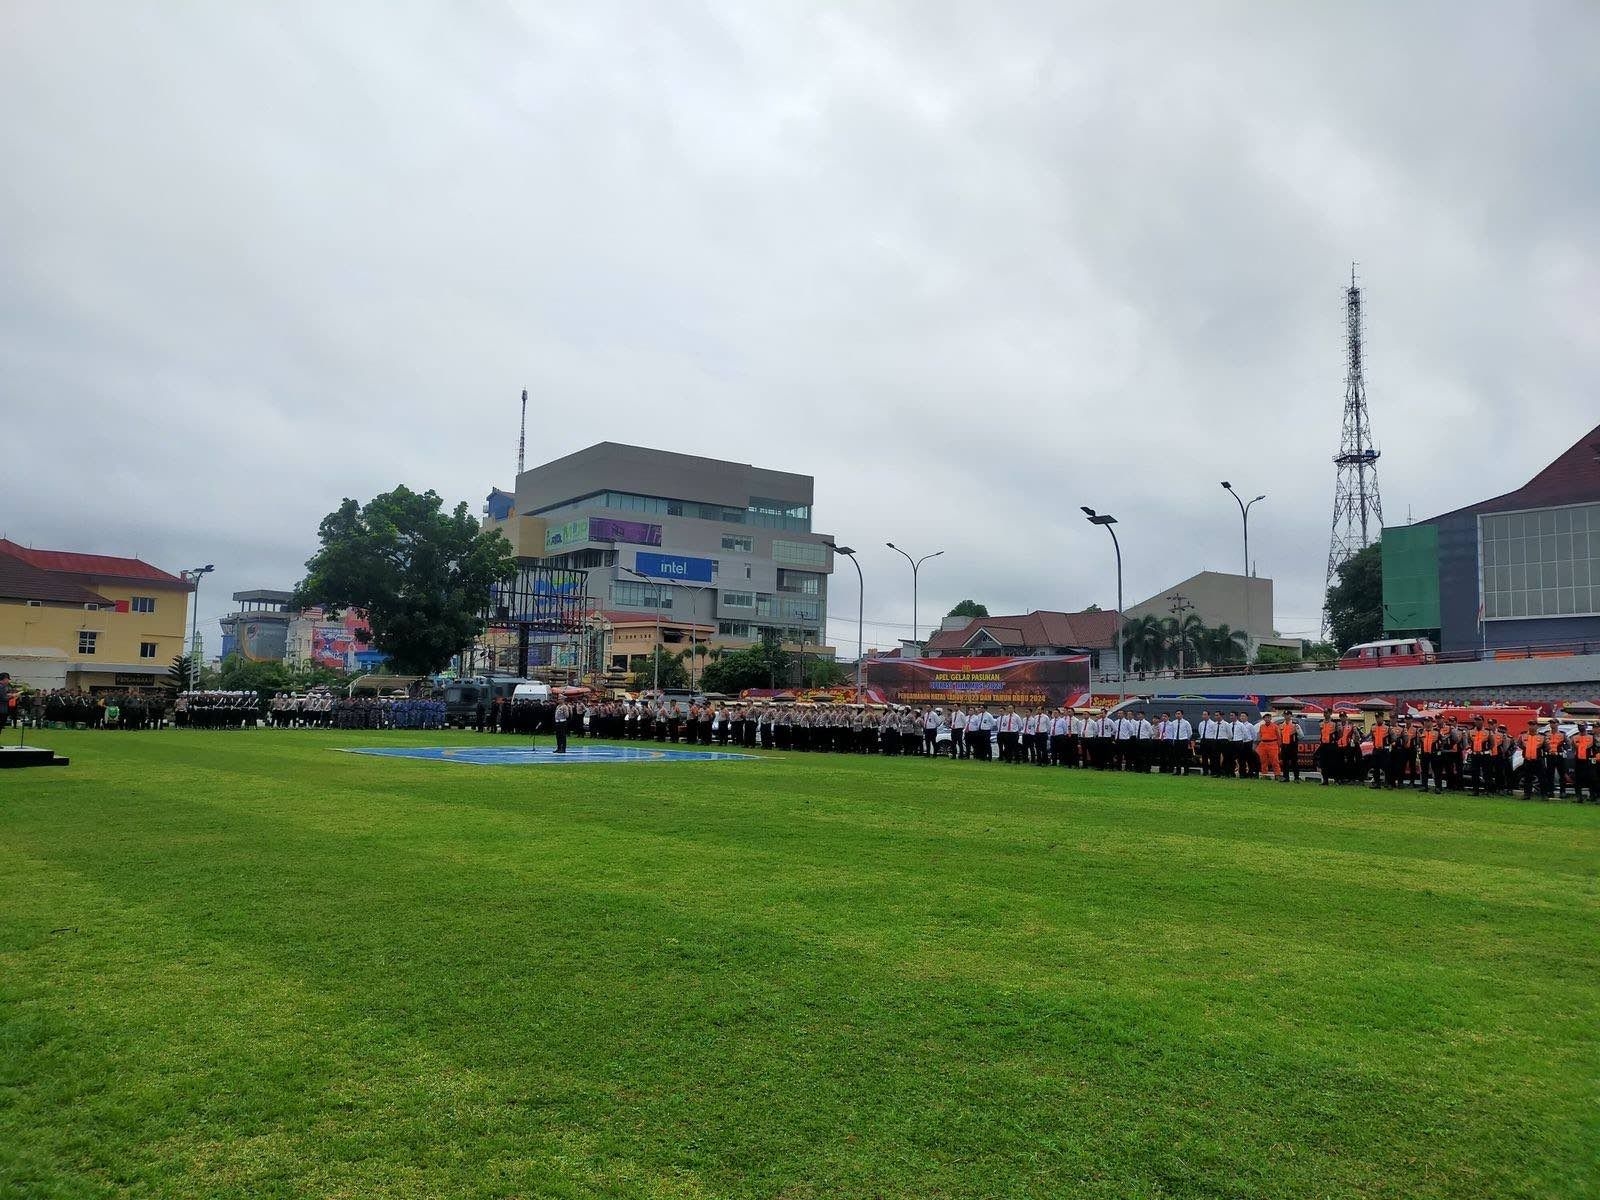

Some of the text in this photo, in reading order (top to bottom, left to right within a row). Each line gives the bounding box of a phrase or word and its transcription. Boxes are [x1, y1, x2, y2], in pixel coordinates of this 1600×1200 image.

[660, 561, 687, 574] intel
[971, 673, 999, 681] PASUKAN
[1029, 694, 1046, 702] 2024
